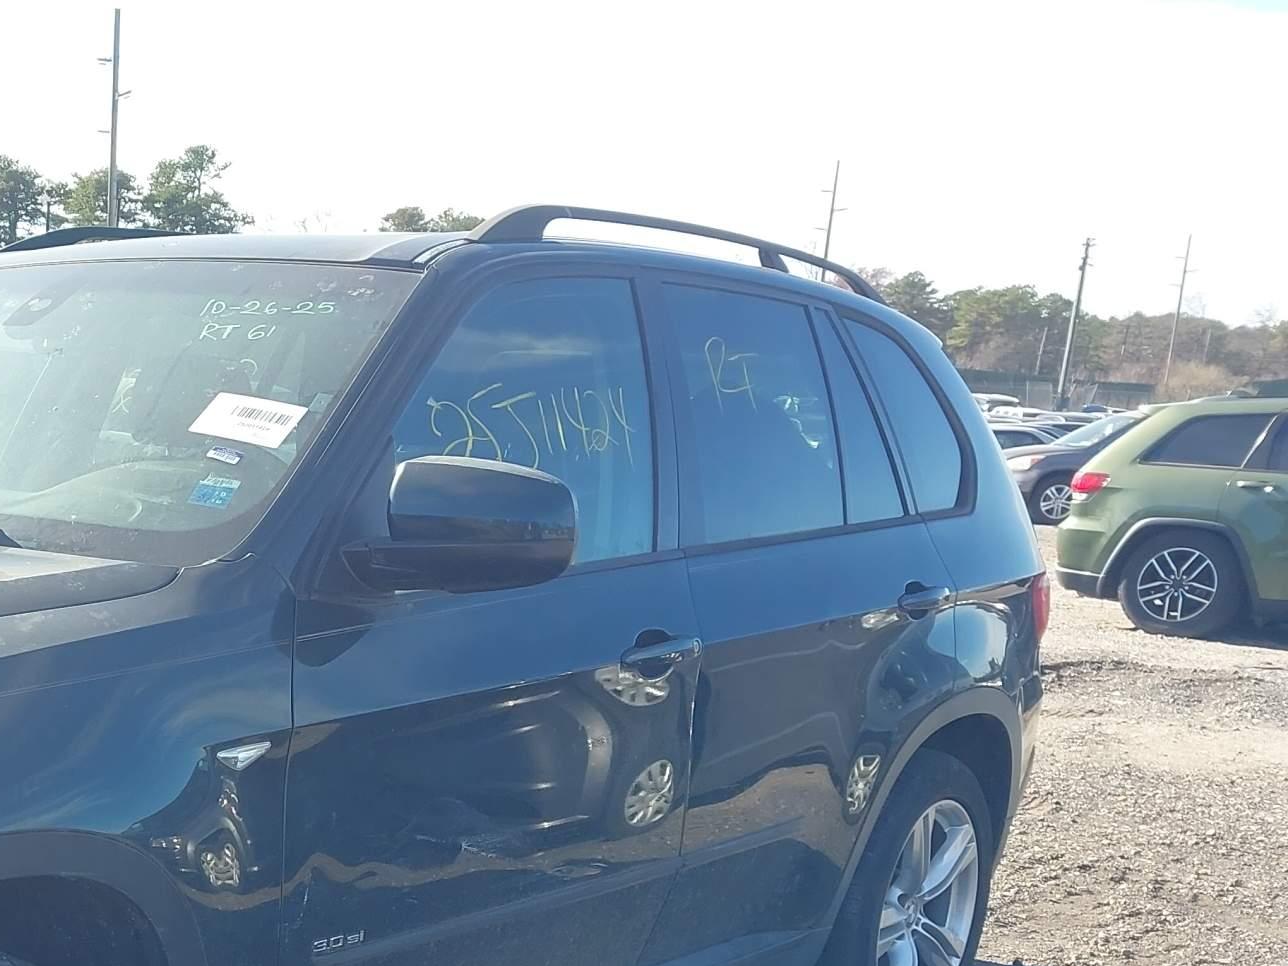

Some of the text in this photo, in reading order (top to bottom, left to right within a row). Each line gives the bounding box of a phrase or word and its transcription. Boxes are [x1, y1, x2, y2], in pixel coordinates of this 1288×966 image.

[200, 299, 336, 316] 10-26-25
[200, 323, 276, 340] RT 61
